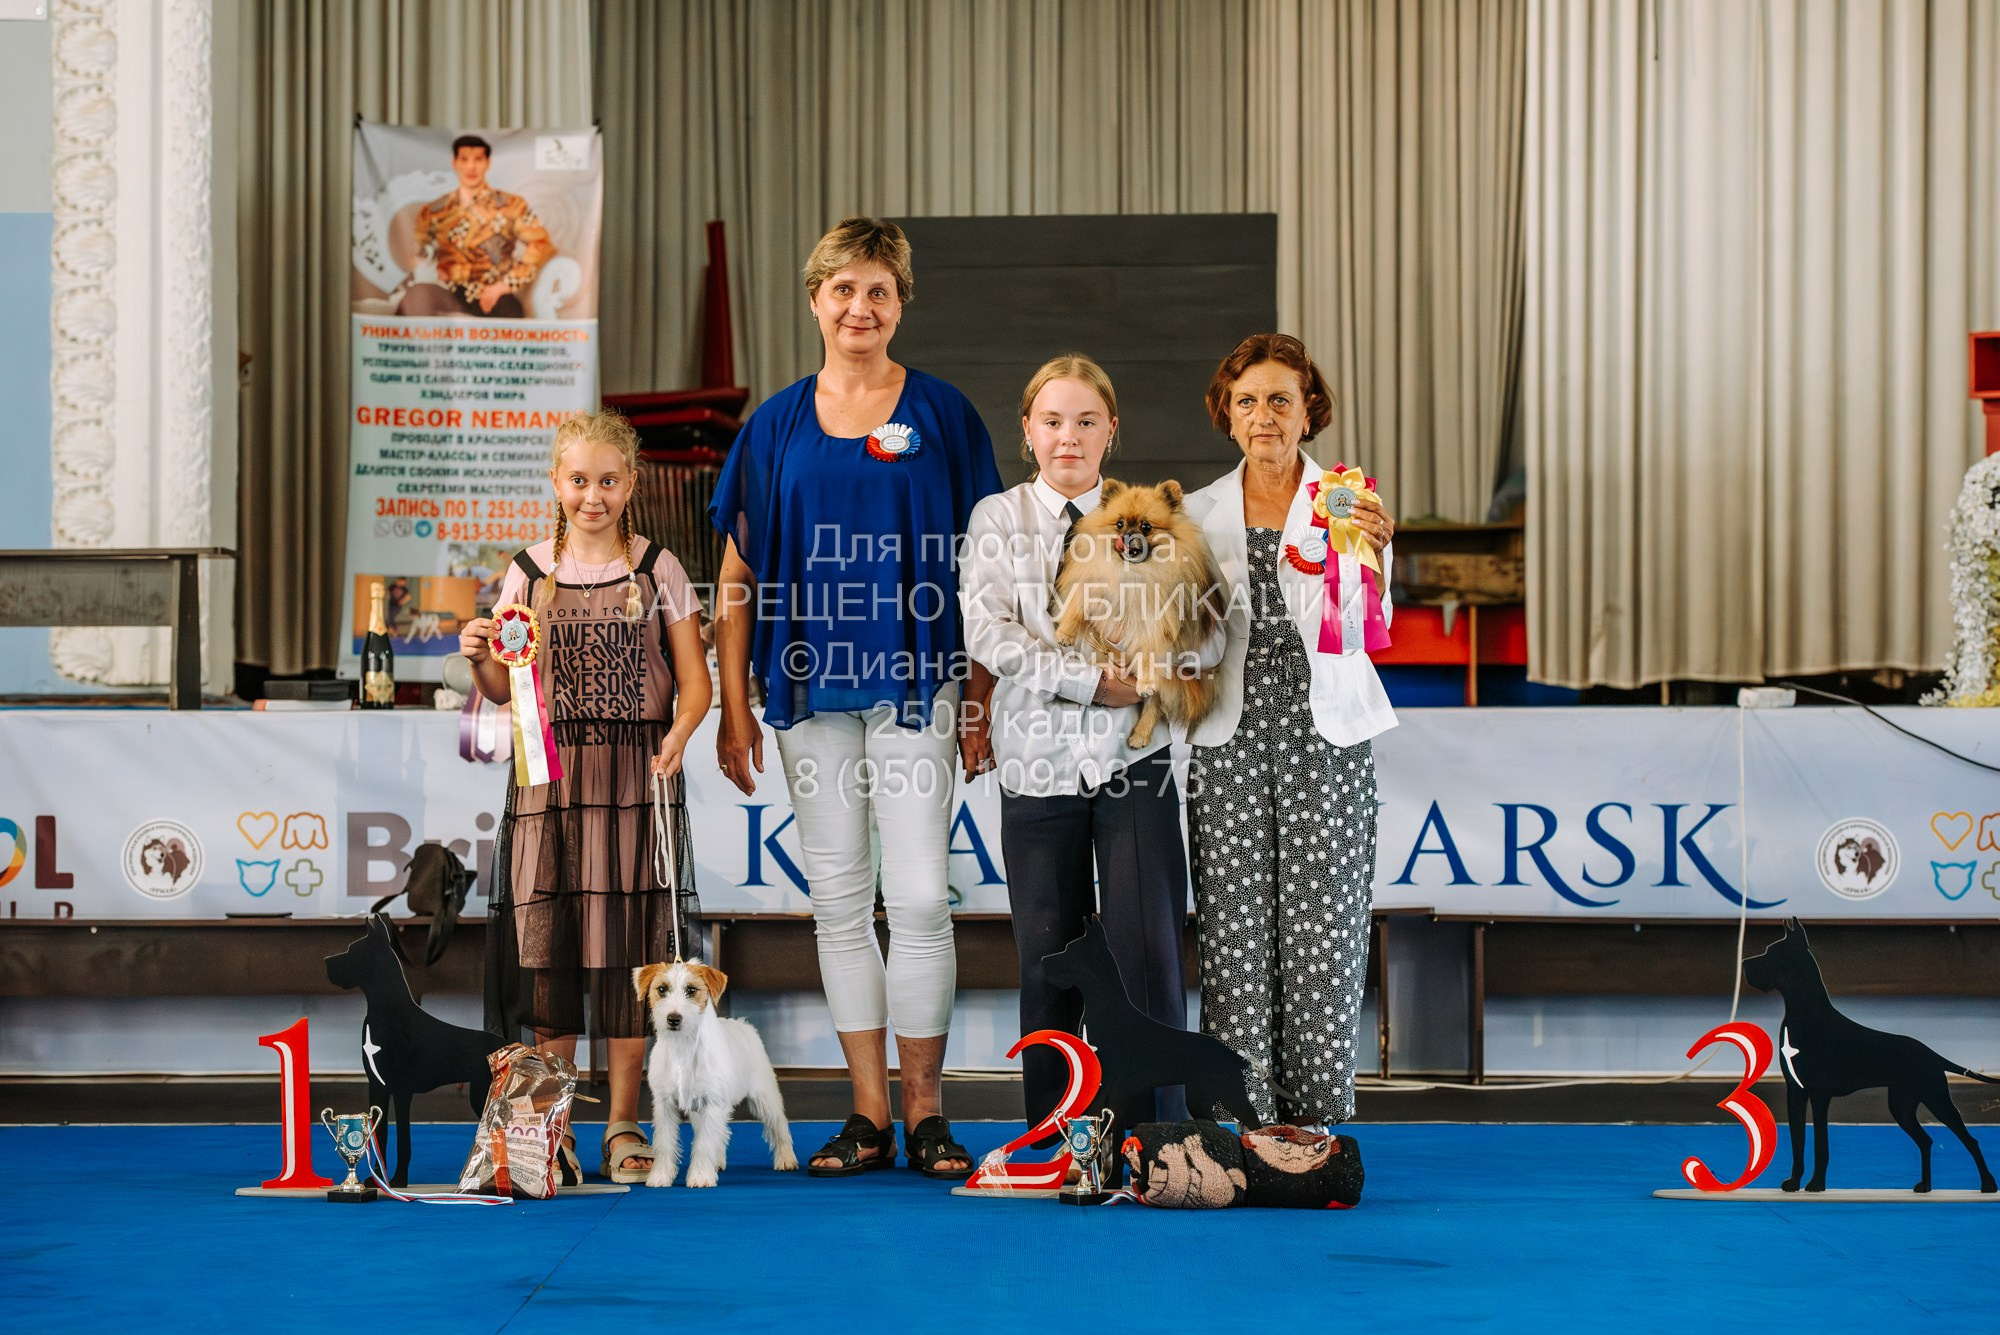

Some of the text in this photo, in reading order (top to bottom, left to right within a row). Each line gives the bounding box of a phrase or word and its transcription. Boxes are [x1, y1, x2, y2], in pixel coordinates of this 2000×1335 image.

[361, 325, 588, 341] УНИКАЛЬНАЯ ВОЗМОЖНОСТЬ
[493, 391, 525, 400] МИРА
[357, 406, 584, 429] GREGOR NEMANI
[457, 434, 463, 444] В
[375, 498, 553, 518] ЗАПИСЬ ПО Т. 251-03-1
[437, 522, 551, 541] 8-913-534-03-1
[547, 609, 591, 619] BORN
[602, 606, 622, 616] TO
[549, 622, 647, 649] AWESOME
[258, 1017, 334, 1189] 1
[966, 1029, 1102, 1189] 2
[1681, 1021, 1778, 1192] 3
